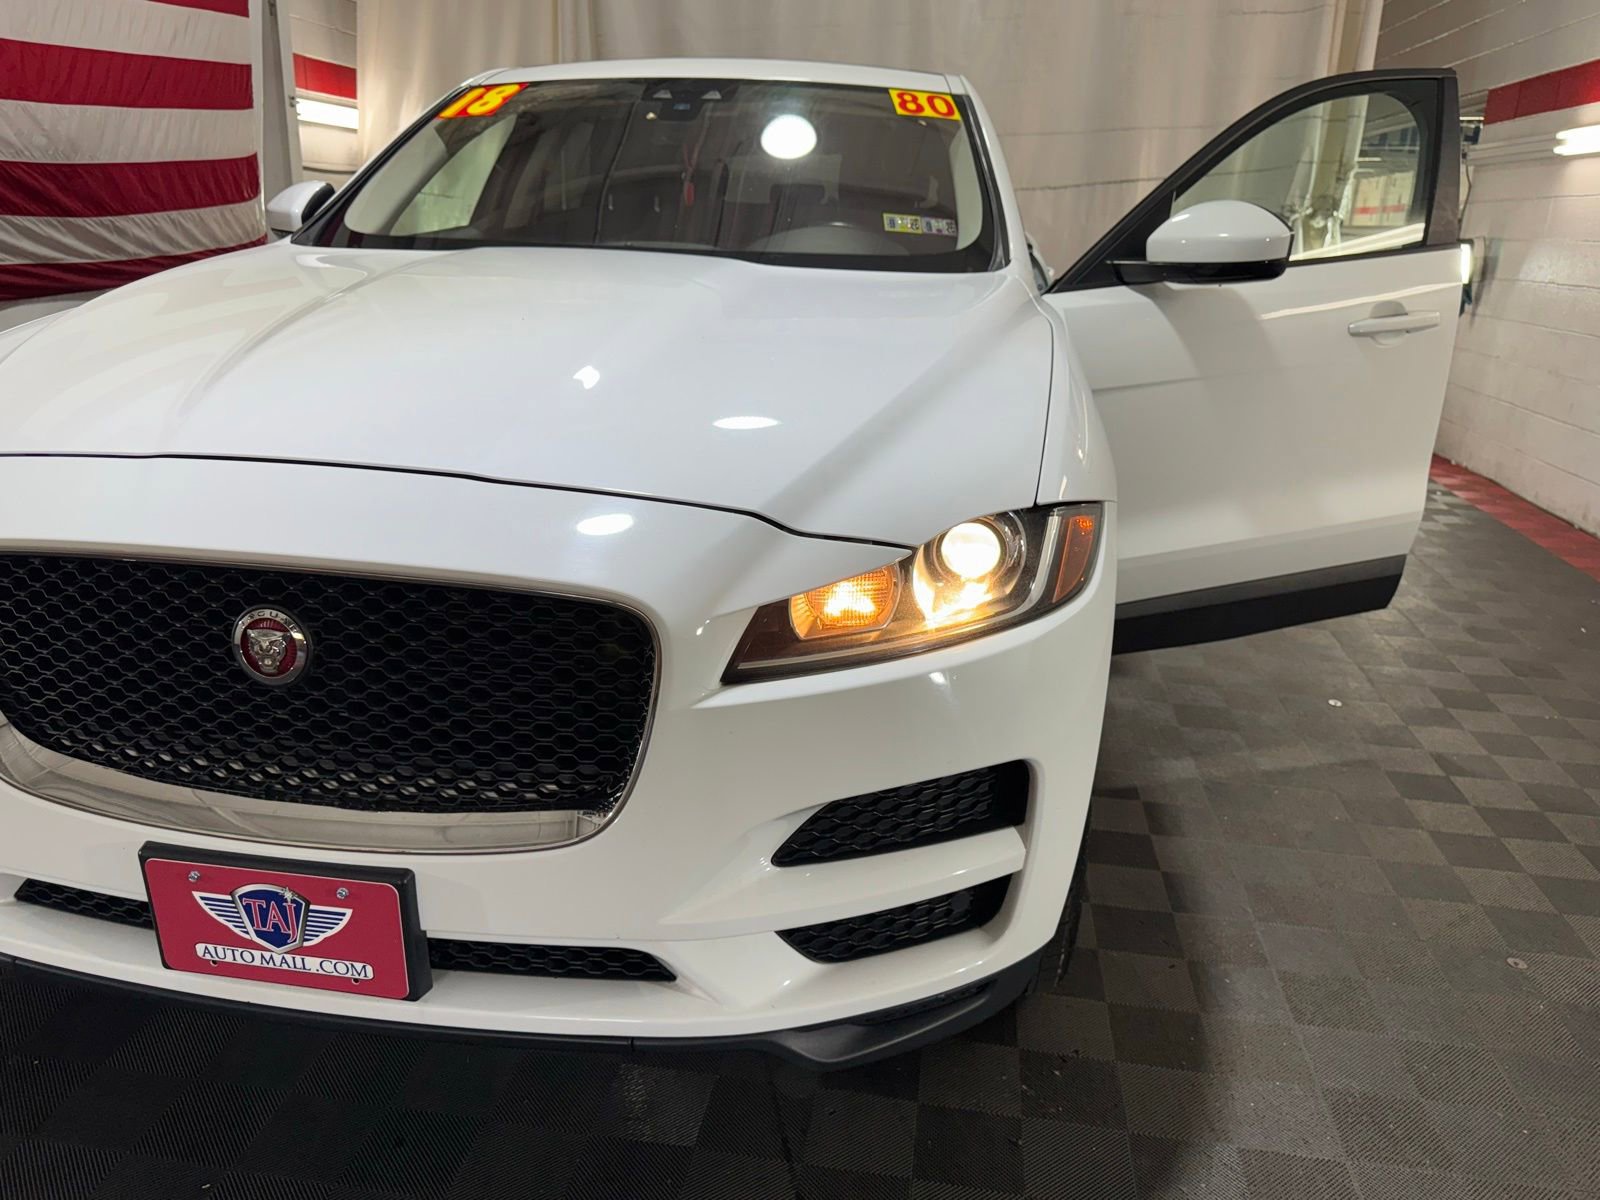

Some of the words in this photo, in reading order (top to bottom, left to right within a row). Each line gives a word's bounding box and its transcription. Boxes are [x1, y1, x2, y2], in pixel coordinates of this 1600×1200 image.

[440, 84, 521, 118] 18
[896, 91, 956, 117] 80
[242, 897, 298, 943] TAJ
[202, 944, 255, 964] AUTO
[260, 952, 312, 971] MALL
